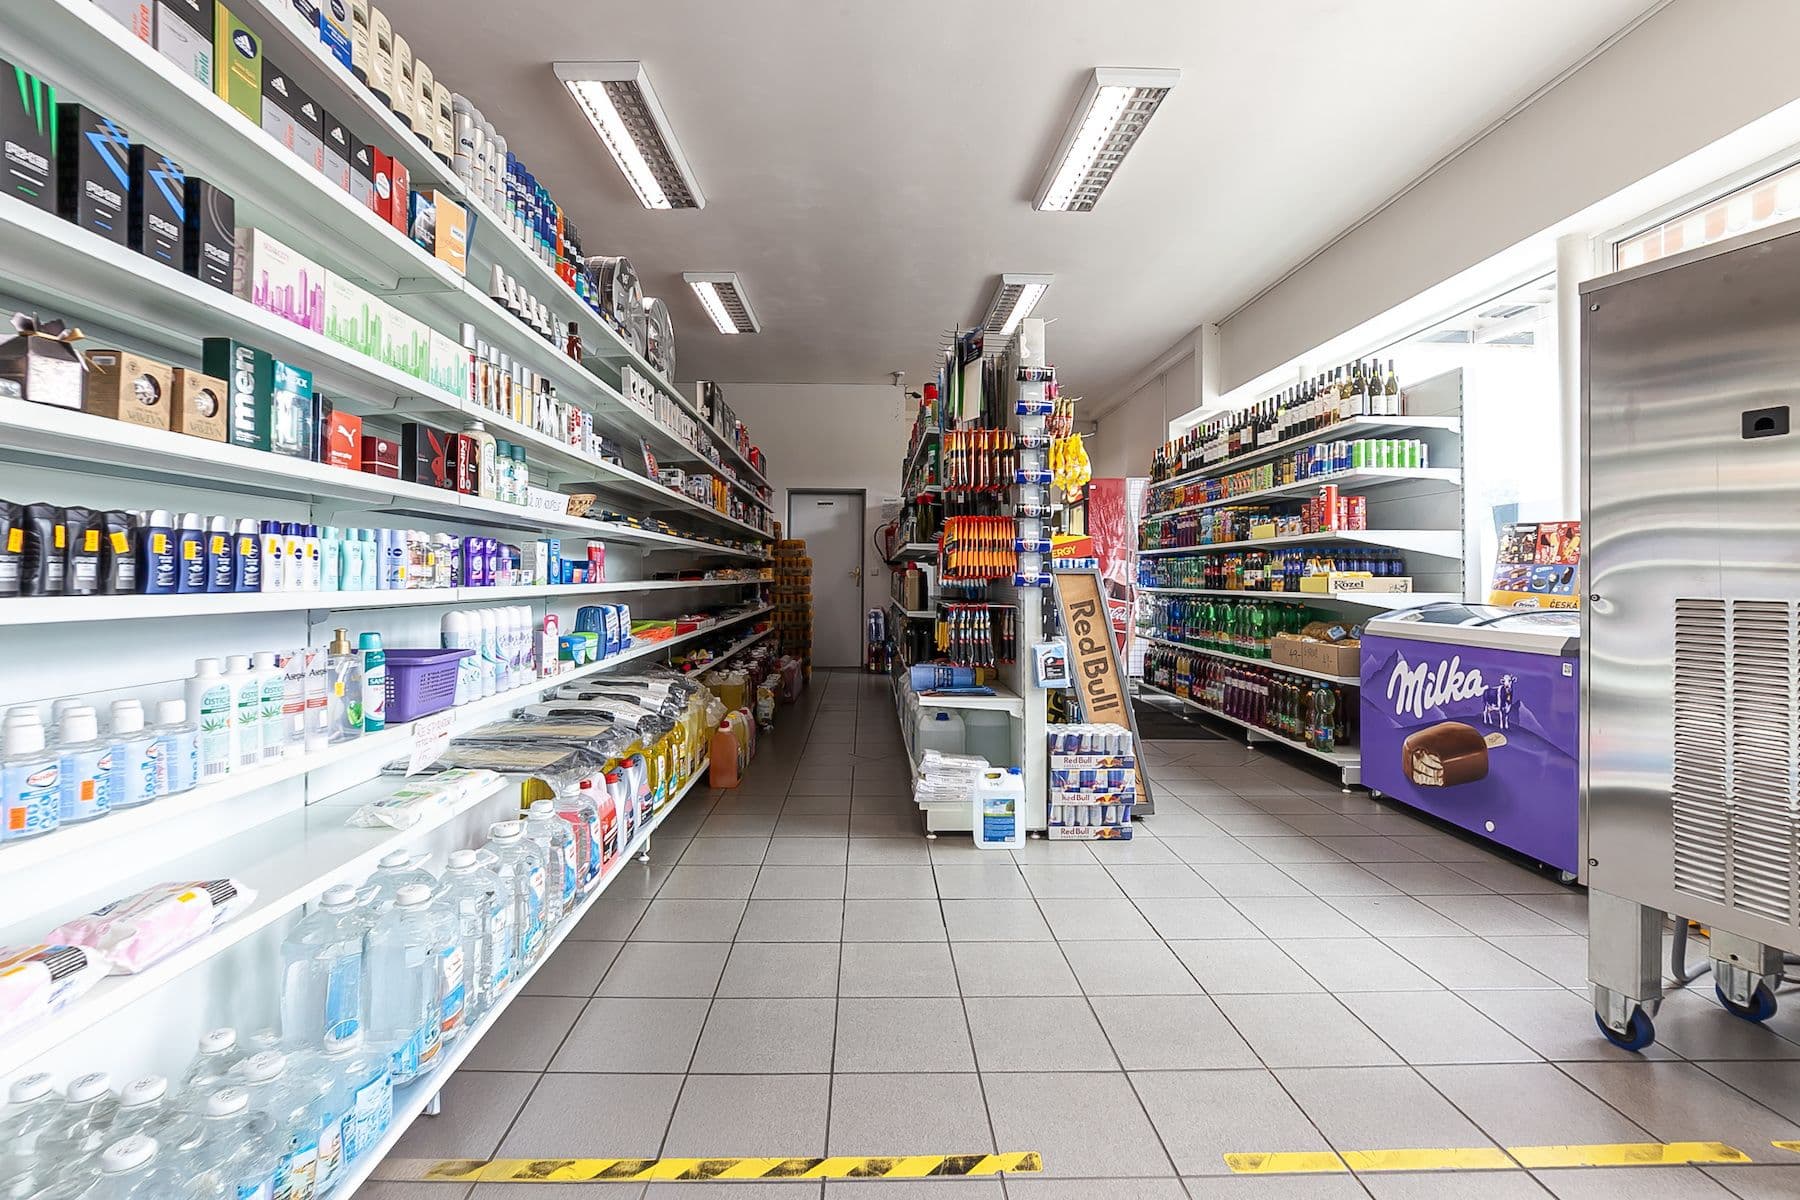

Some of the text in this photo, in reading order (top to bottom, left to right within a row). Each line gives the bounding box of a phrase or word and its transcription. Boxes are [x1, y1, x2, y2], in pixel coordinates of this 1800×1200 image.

[235, 346, 255, 431] men
[1334, 580, 1364, 590] Kozel
[1549, 598, 1578, 609] ČESKÁ
[1070, 599, 1106, 656] Red
[1083, 656, 1119, 712] Bull
[1387, 656, 1488, 718] Milka
